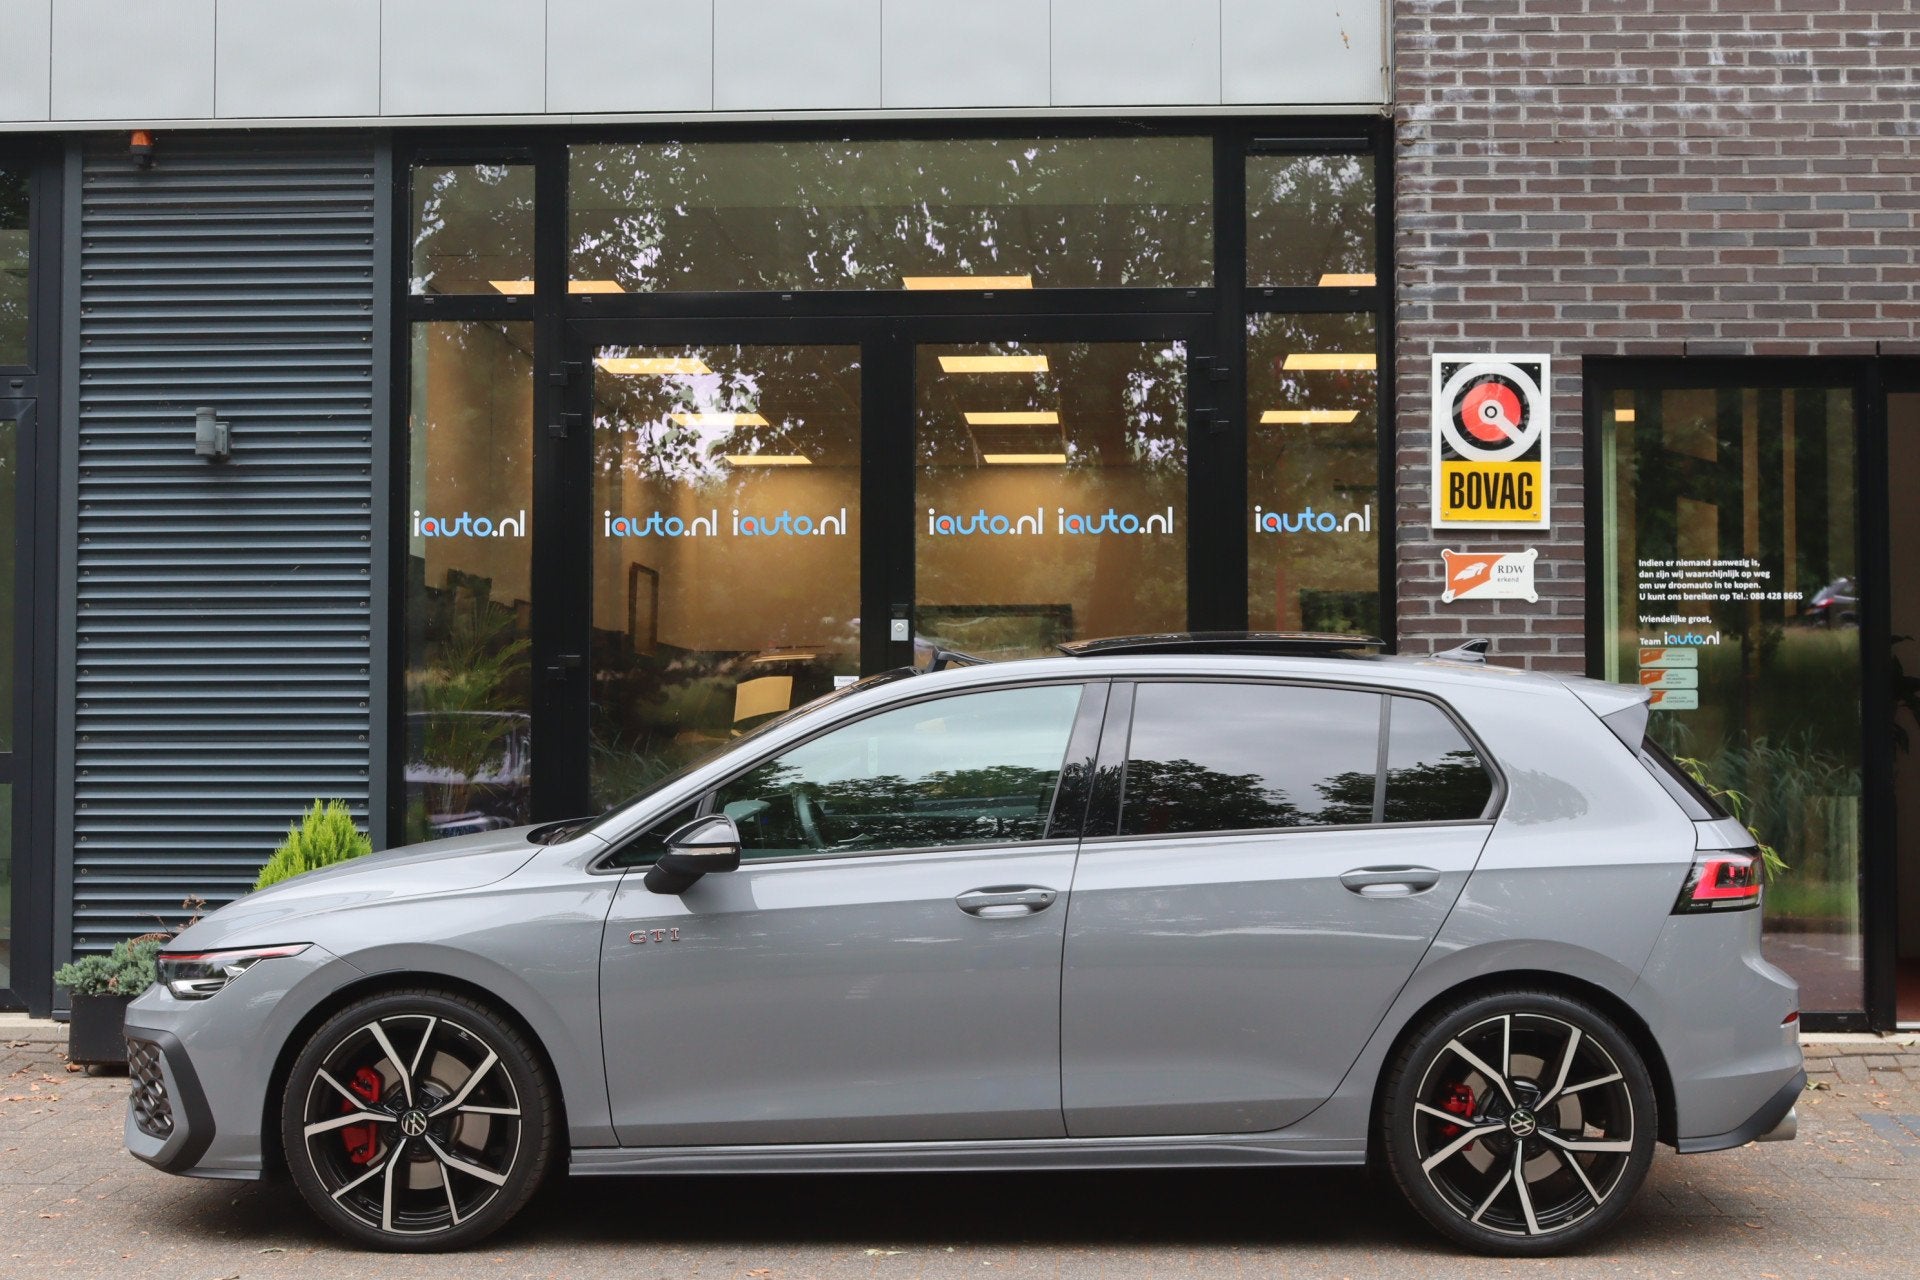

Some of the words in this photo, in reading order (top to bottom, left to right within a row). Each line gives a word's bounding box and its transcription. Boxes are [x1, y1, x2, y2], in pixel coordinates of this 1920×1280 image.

[1449, 471, 1533, 510] BOVAG
[413, 510, 525, 537] iauto.nl
[604, 509, 718, 537] iauto.nl
[732, 507, 847, 536] iauto.nl
[928, 507, 1044, 535] iauto.nl
[1057, 506, 1173, 534] iauto.nl
[1254, 504, 1371, 533] iauto.nl
[1497, 565, 1525, 574] RDW
[1639, 559, 1664, 567] Indien
[1675, 559, 1711, 567] niemand
[1712, 559, 1750, 568] aanwezig
[1751, 559, 1760, 568] is,
[1639, 570, 1654, 578] dan
[1655, 570, 1670, 579] zijn
[1671, 570, 1684, 579] wij
[1685, 570, 1740, 579] waarschijnlijk
[1741, 571, 1752, 579] op
[1753, 571, 1771, 579] weg
[1668, 581, 1713, 589] droomauto
[1714, 581, 1723, 589] in
[1723, 581, 1733, 589] te
[1734, 581, 1761, 590] kopen.
[1683, 592, 1719, 600] bereiken
[1719, 593, 1731, 601] op
[1732, 592, 1749, 600] Tel.:
[1750, 591, 1766, 600] 088
[1767, 591, 1782, 600] 428
[1783, 591, 1803, 600] 8665
[1639, 615, 1687, 624] Vriendelijke
[1688, 615, 1712, 624] groet,
[1664, 631, 1720, 645] iauto.nl
[629, 927, 680, 944] GTI
